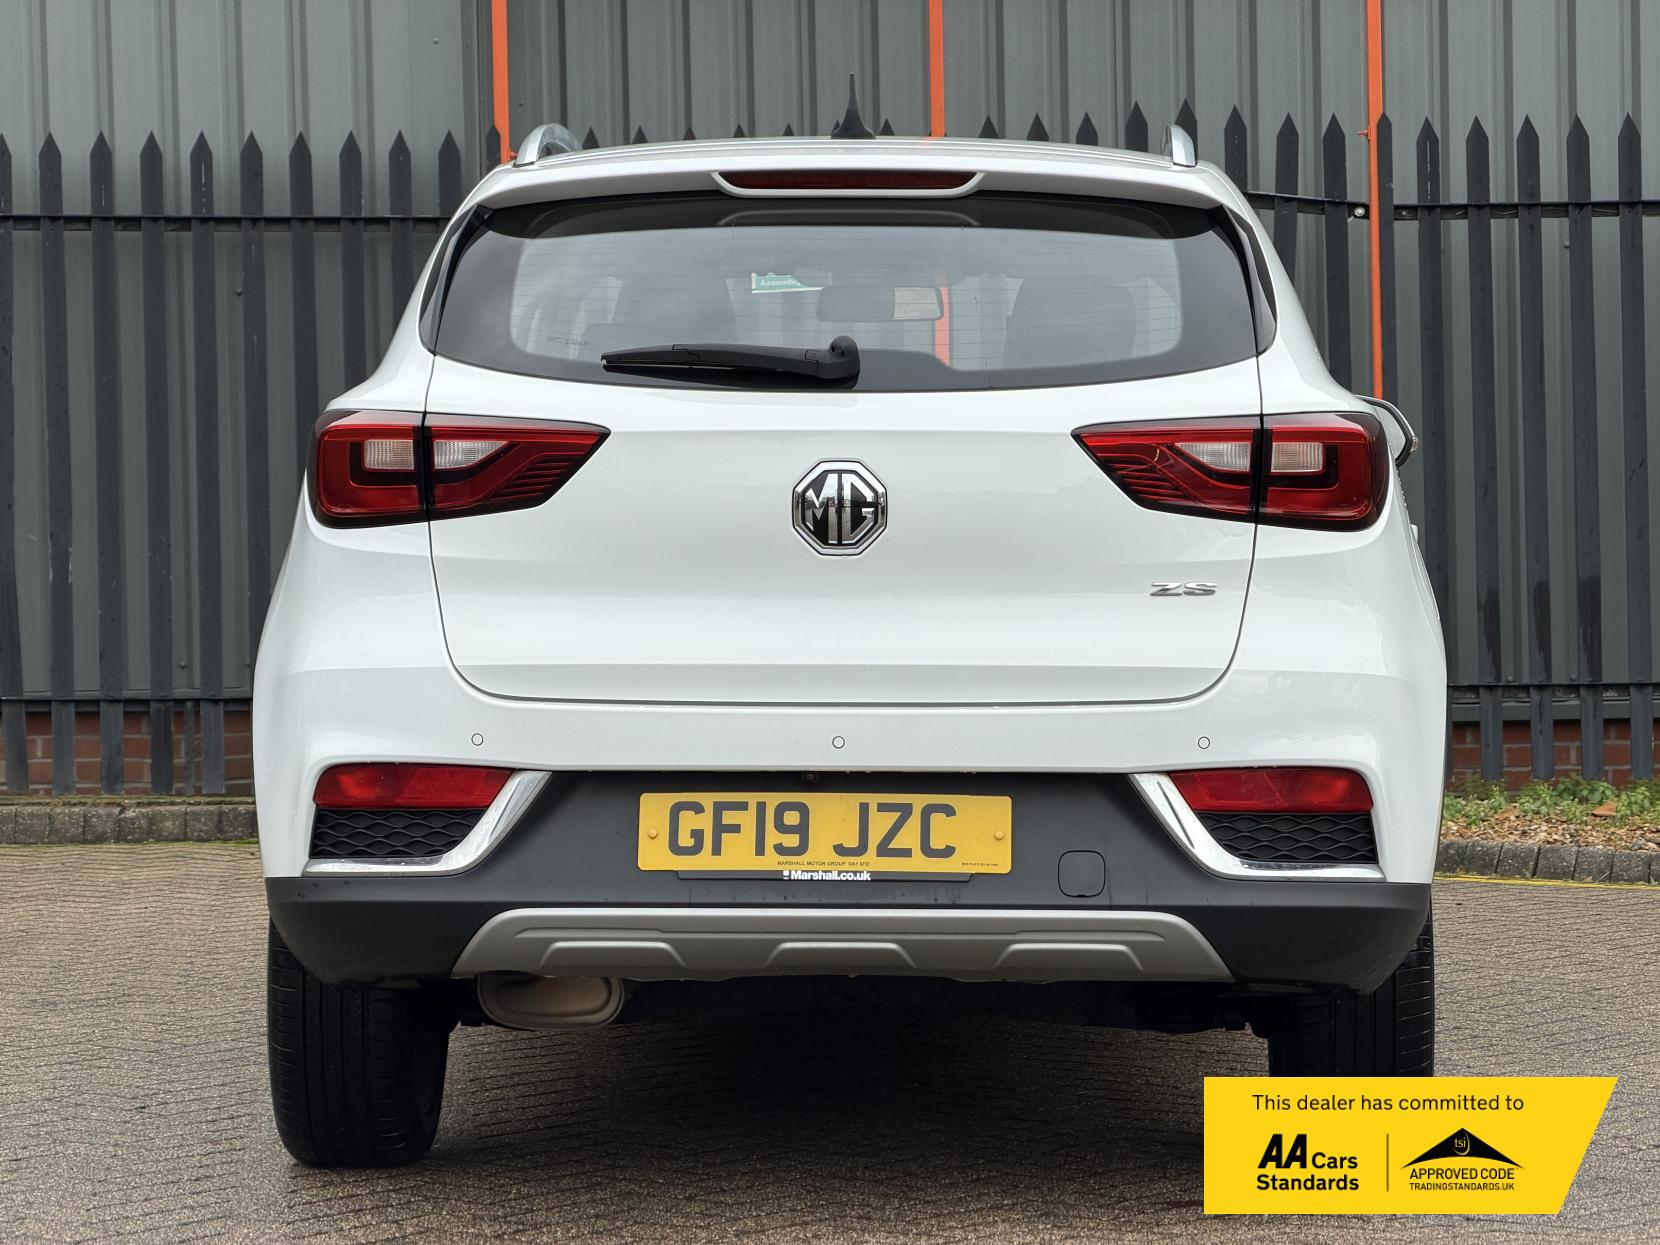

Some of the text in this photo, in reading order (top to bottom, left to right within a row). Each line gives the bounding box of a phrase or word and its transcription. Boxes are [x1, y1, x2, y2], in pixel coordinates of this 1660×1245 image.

[804, 473, 876, 544] MG
[1150, 582, 1218, 597] ZS
[668, 800, 957, 859] GF19 JZC
[791, 870, 871, 880] Marshall.co.uk
